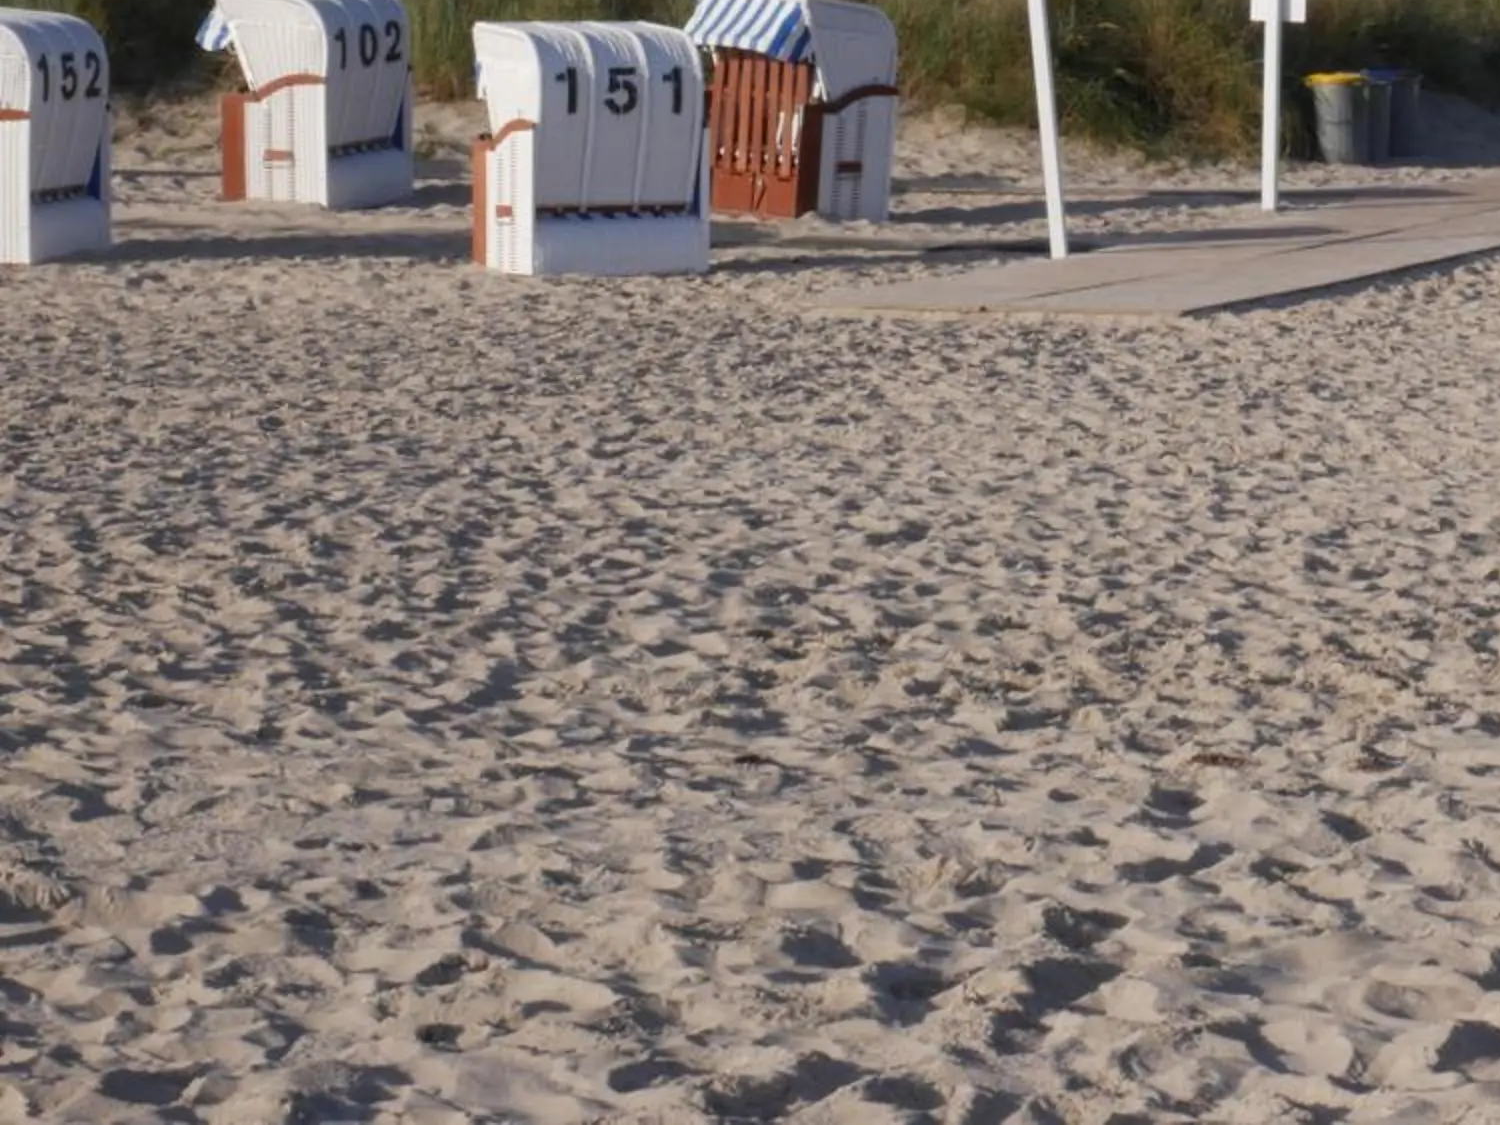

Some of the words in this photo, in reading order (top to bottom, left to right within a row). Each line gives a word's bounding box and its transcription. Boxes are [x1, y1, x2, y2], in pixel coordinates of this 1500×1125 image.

[333, 19, 402, 71] 102
[37, 49, 102, 104] 152
[555, 66, 682, 115] 151
